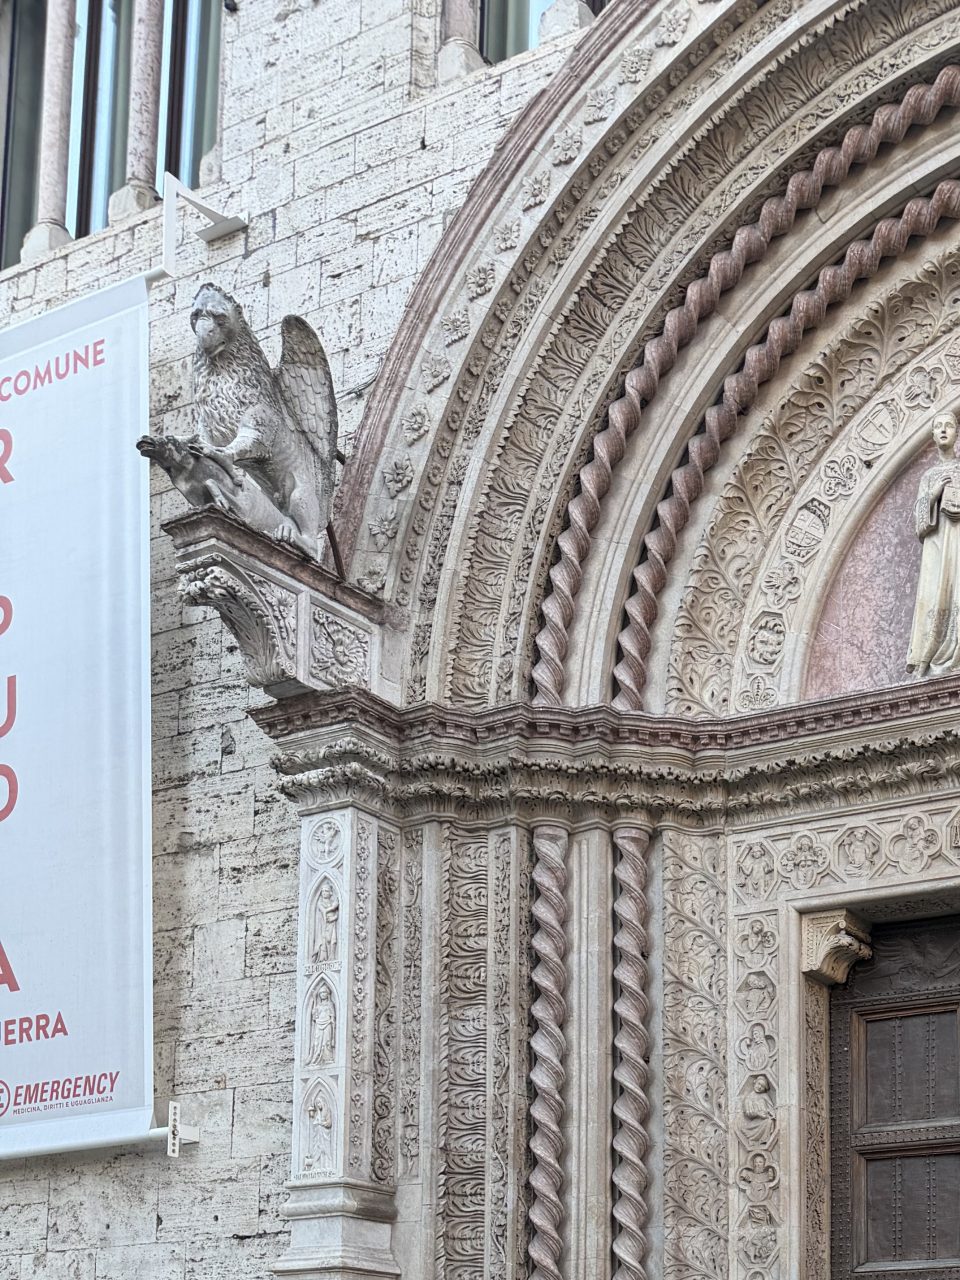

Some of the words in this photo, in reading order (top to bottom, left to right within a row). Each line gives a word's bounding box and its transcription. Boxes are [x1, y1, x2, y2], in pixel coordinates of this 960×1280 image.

[0, 338, 106, 402] COMUNE
[0, 1011, 69, 1046] ERRA
[12, 1105, 43, 1116] MEDICINA,
[43, 1102, 65, 1111] DIRITTI
[70, 1095, 114, 1107] UGUAGLIANZA
[13, 1071, 120, 1107] EMERGENCY
